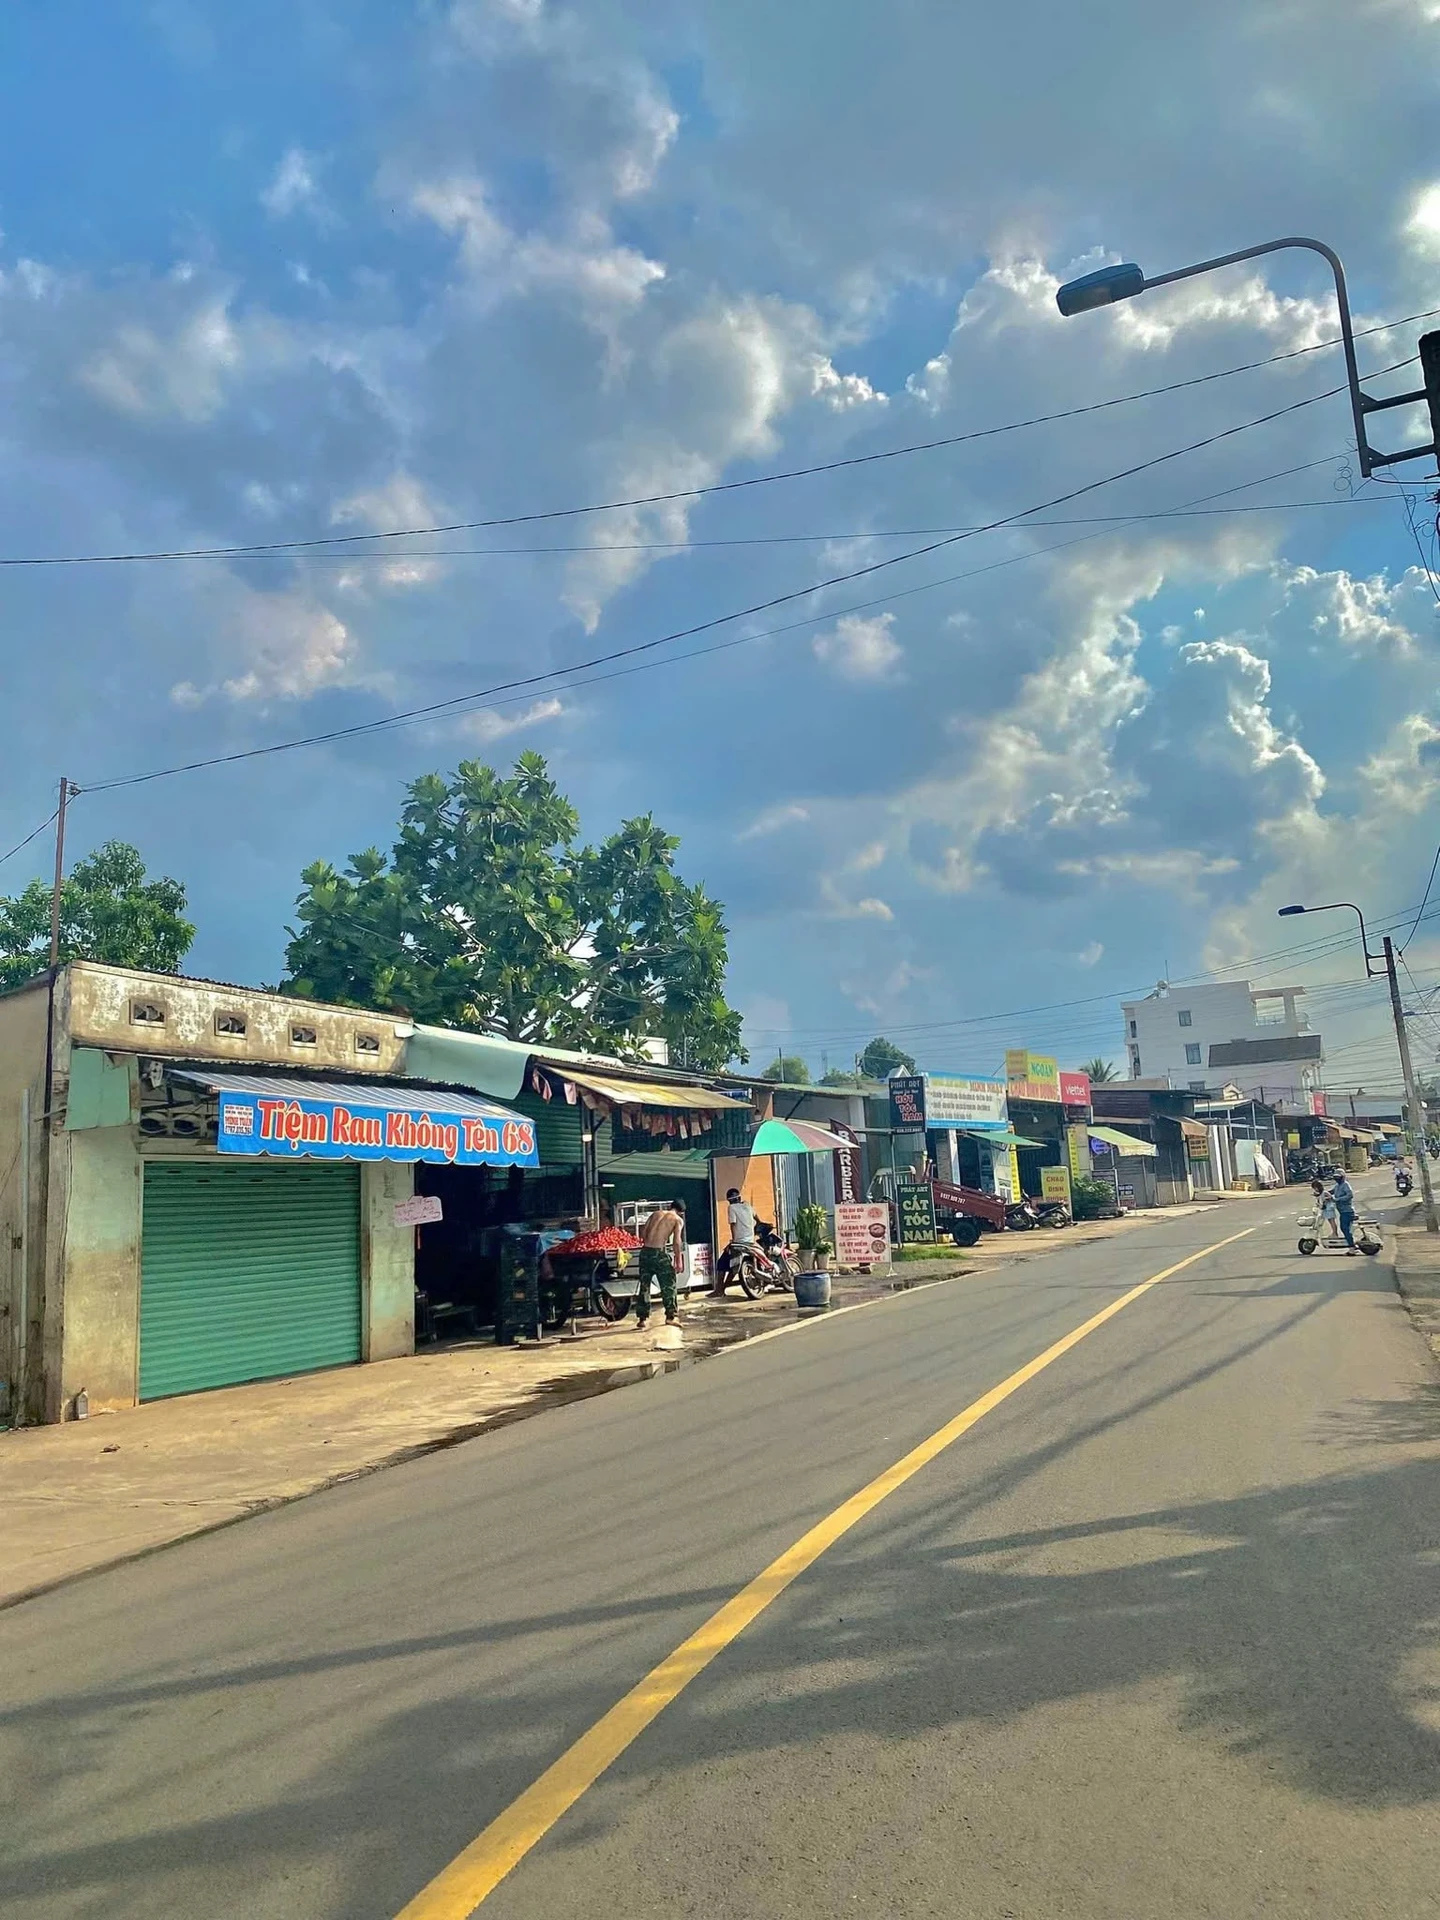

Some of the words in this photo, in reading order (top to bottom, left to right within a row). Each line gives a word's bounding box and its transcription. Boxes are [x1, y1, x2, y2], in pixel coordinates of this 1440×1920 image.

[258, 1100, 326, 1151] Tiệm
[332, 1107, 380, 1147] Rau
[386, 1112, 459, 1161] Không
[461, 1117, 498, 1153] Tên
[501, 1120, 534, 1155] 68
[838, 1130, 853, 1200] BARBER
[902, 1195, 929, 1211] CẮT
[903, 1212, 930, 1226] TÓC
[904, 1230, 934, 1240] NAM
